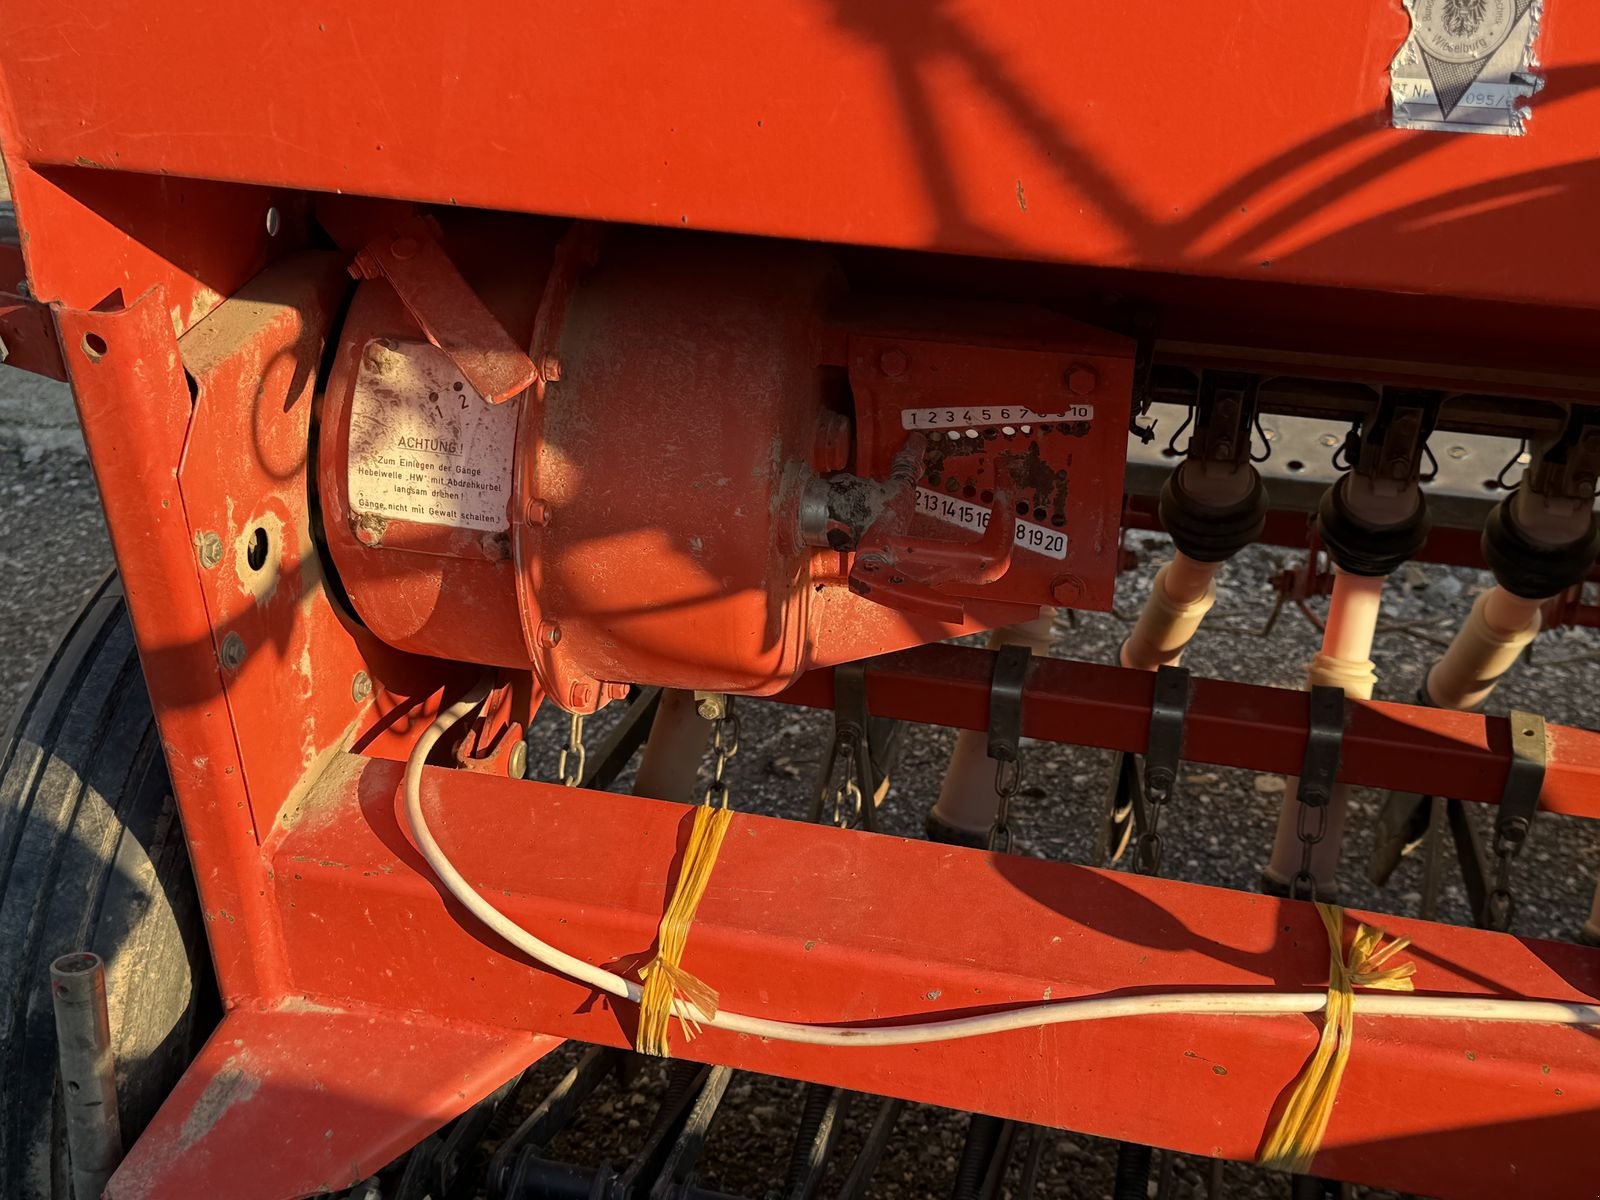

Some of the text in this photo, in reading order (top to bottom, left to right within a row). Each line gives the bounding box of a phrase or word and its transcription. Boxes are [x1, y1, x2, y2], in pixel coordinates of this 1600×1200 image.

[435, 394, 469, 419] 1 2
[911, 413, 918, 425] 1
[928, 411, 938, 424] 2
[945, 410, 955, 422] 3
[963, 410, 972, 421] 4
[982, 409, 992, 420] 5
[1001, 408, 1011, 419] 6
[1019, 408, 1029, 419] 7
[1071, 406, 1088, 418] 10
[377, 455, 396, 466] Zum
[399, 458, 435, 471] Einlegen
[438, 463, 451, 472] der
[358, 466, 403, 480] Hebelwelle
[430, 475, 444, 485] mit
[447, 478, 502, 492] Abdrehkurbel
[394, 484, 428, 496] langsam
[388, 503, 408, 512] nicht
[411, 505, 425, 514] mit
[428, 507, 457, 518] Gewalt
[924, 495, 938, 511] 13
[941, 501, 956, 517] 14
[958, 506, 974, 523] 15
[1015, 524, 1026, 540] 8
[1028, 530, 1043, 546] 19
[1044, 535, 1064, 552] 20
